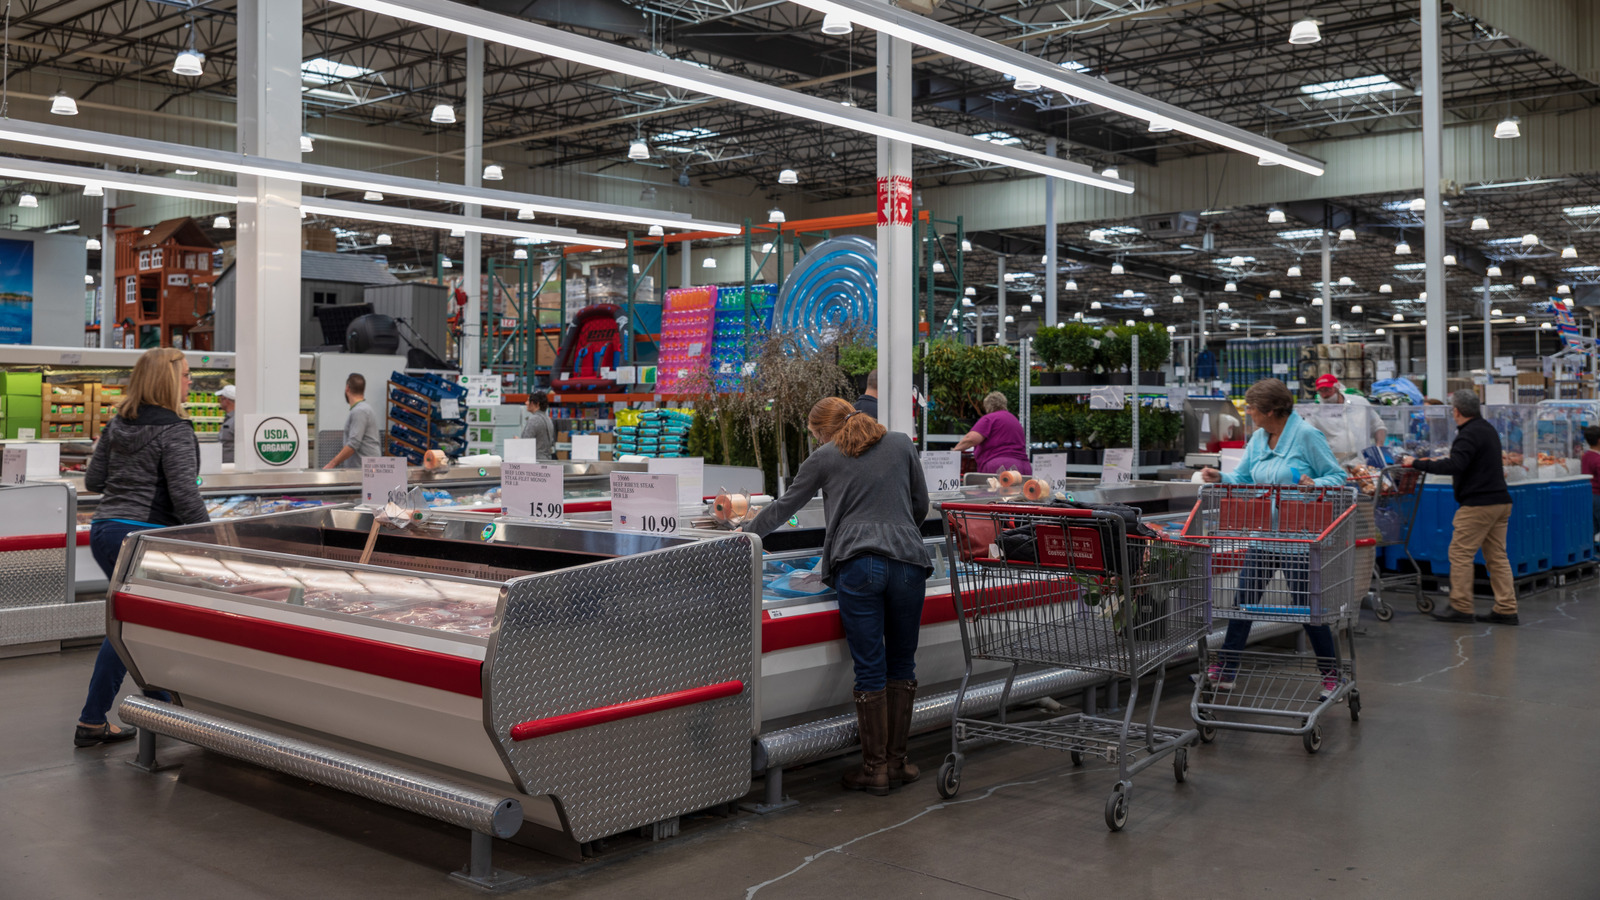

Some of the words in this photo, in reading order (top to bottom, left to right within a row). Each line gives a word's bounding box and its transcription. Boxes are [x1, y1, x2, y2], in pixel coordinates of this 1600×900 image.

[264, 429, 288, 439] USDA
[261, 444, 293, 452] ORGANIC
[1117, 473, 1130, 482] 8.99
[938, 479, 959, 491] 26.99
[530, 502, 562, 519] 15.99
[641, 516, 676, 533] 10.99
